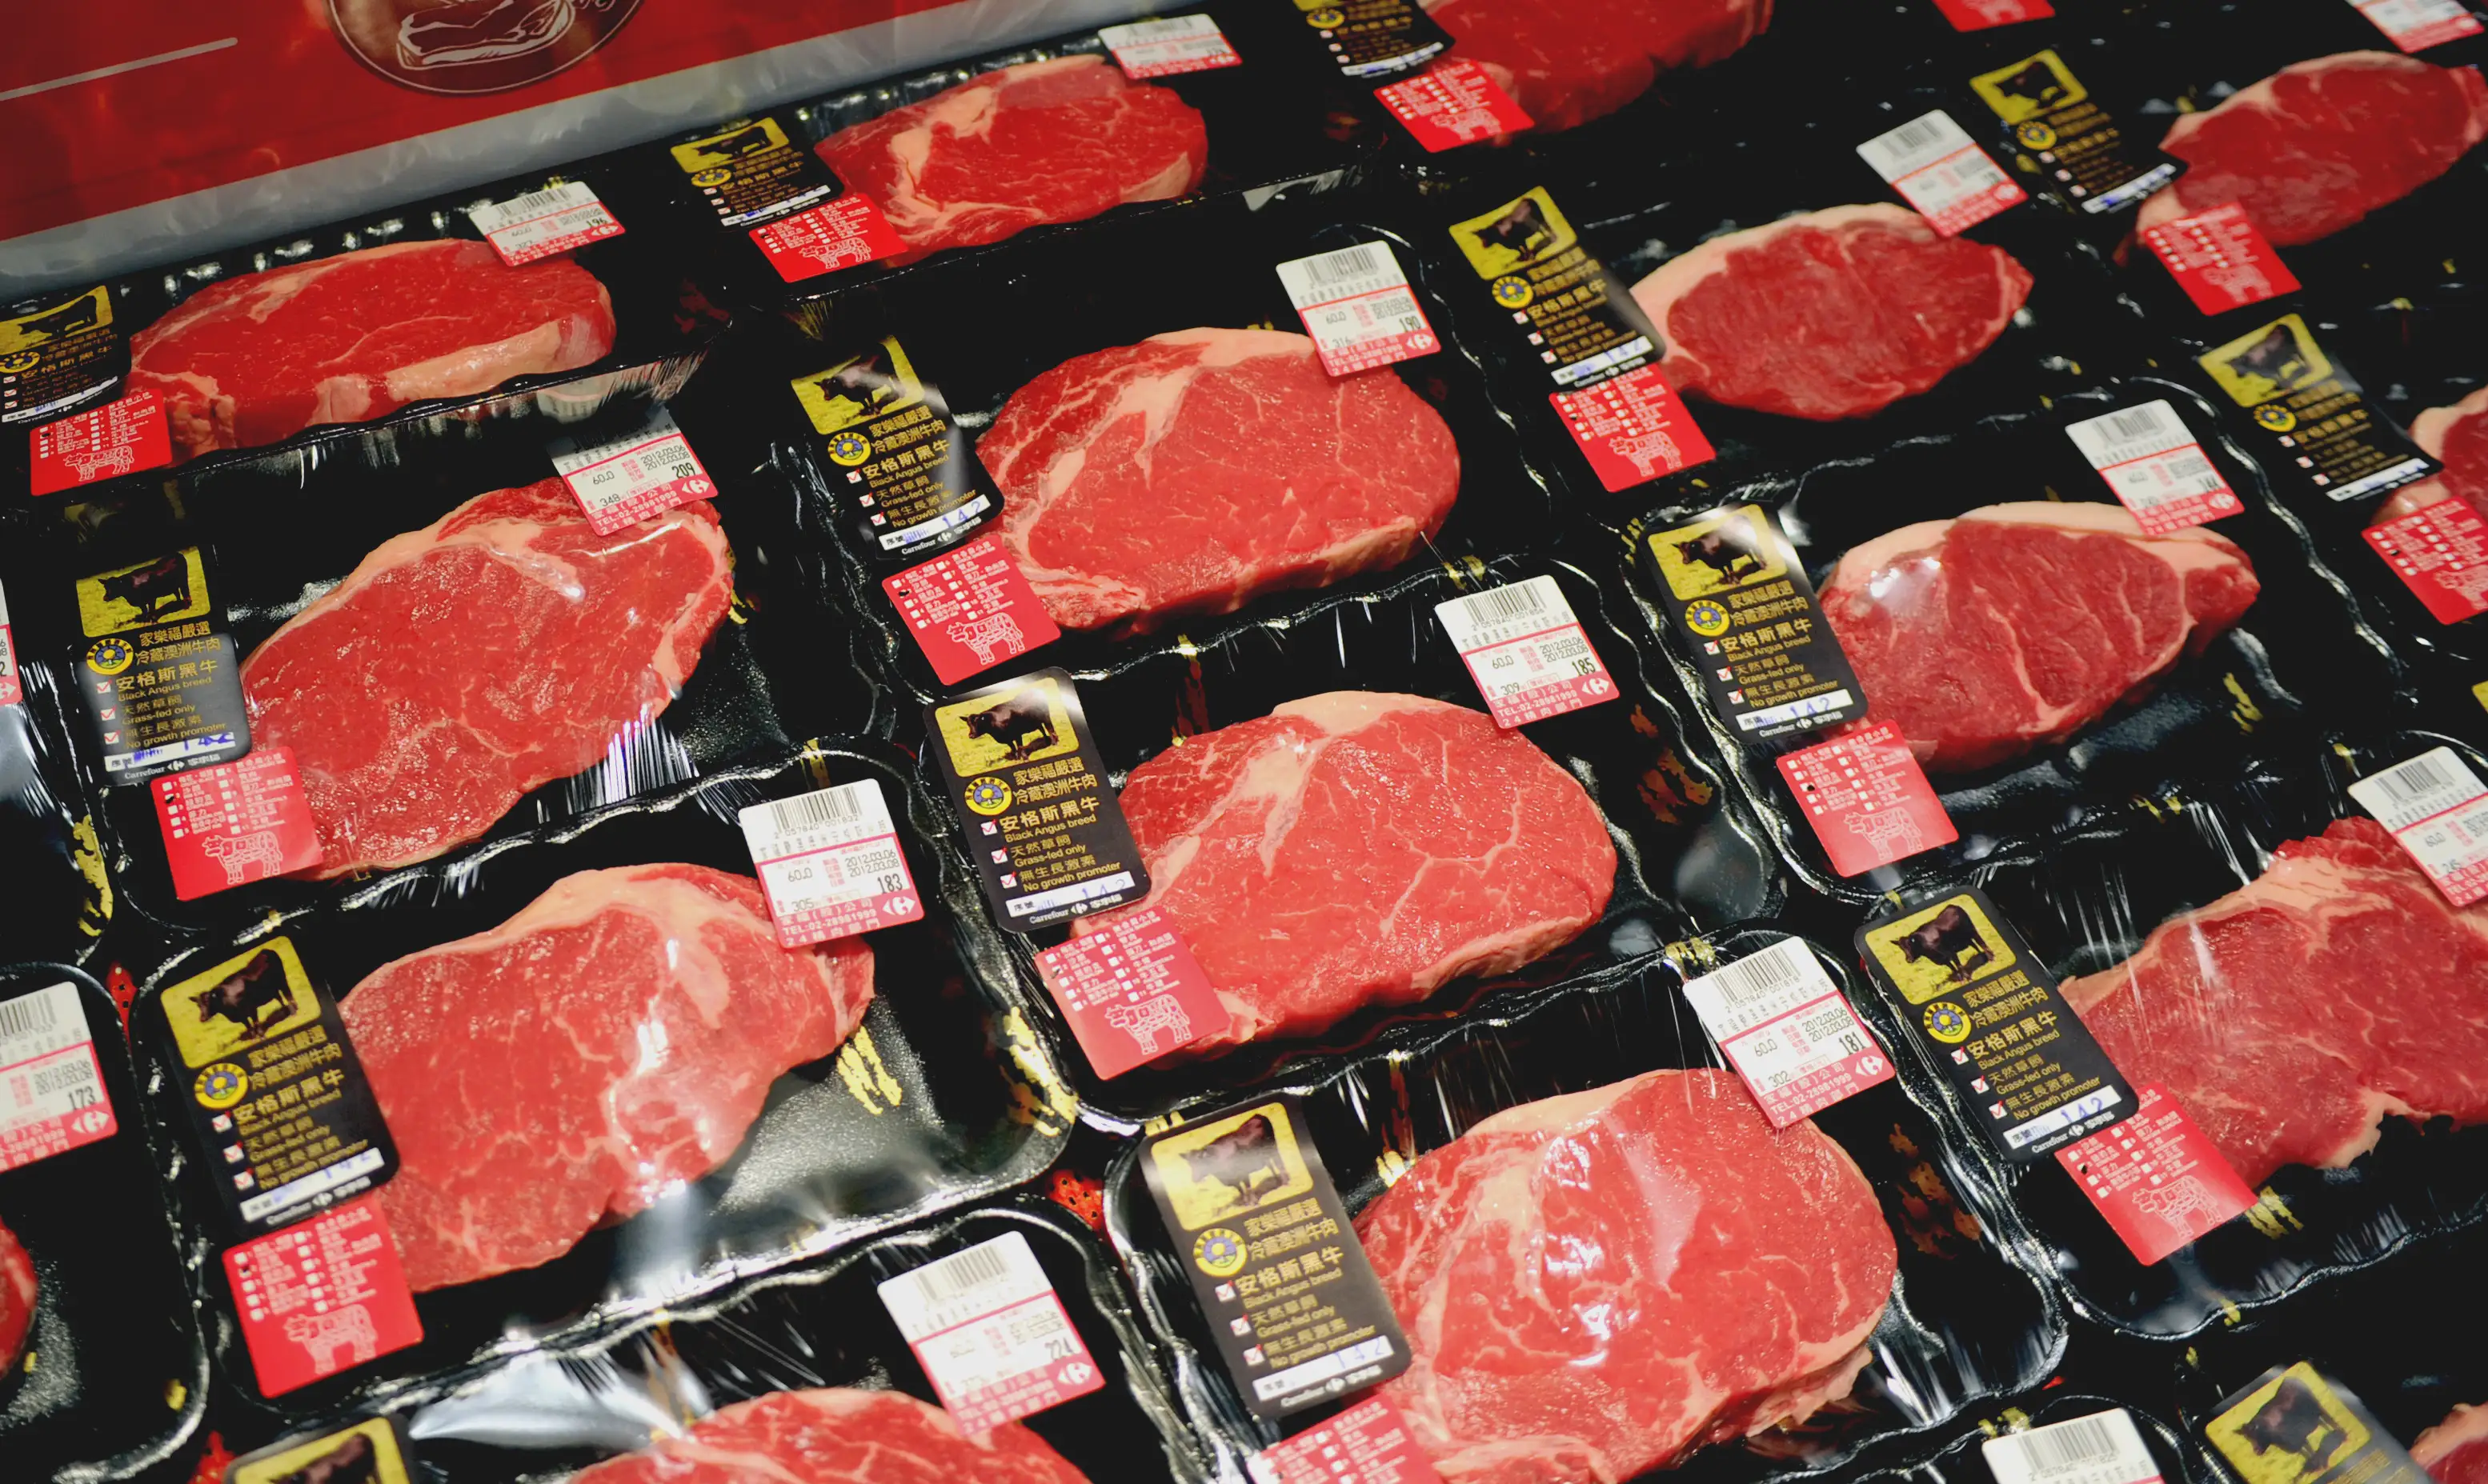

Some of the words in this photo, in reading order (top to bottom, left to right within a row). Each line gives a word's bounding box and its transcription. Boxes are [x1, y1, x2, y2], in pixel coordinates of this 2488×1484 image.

[640, 443, 685, 463] 2012.03.06
[645, 450, 690, 470] 2012.03.08
[860, 437, 952, 478] 安格斯黑牛
[590, 471, 614, 485] 60.0
[671, 461, 696, 480] 209
[869, 473, 895, 486] Black
[895, 462, 924, 478] Angus
[923, 453, 949, 466] breed
[599, 494, 621, 506] 348
[880, 486, 924, 506] Grass-fed
[924, 478, 945, 490] only
[892, 516, 907, 526] No
[907, 504, 939, 522] growth
[938, 488, 977, 509] promoter
[900, 536, 936, 554] Carrefour
[1538, 635, 1583, 653] 2012.03.06
[1719, 617, 1813, 652] 安格斯黑牛
[1544, 644, 1588, 662] 2012.03.08
[1727, 650, 1753, 662] Black
[1753, 642, 1783, 657] Angus
[1783, 635, 1810, 647] breed
[1490, 655, 1513, 668] 60.0
[1571, 657, 1596, 676] 185
[1783, 663, 1805, 675] only
[115, 658, 218, 691] 安格斯黑牛
[118, 690, 145, 701] Black
[148, 683, 179, 697] Angus
[182, 676, 210, 688] breed
[1500, 682, 1520, 694] 309
[1749, 698, 1764, 707] No
[1765, 690, 1797, 706] growth
[1797, 680, 1840, 697] promoter
[122, 709, 170, 724] Grass-fed
[173, 704, 194, 716] only
[125, 739, 139, 748] No
[142, 732, 177, 746] growth
[179, 722, 226, 738] promoter
[124, 766, 164, 779] Carrefour
[1012, 756, 1084, 786] 家樂福嚴選
[1012, 772, 1097, 805] 冷藏澳洲牛肉
[998, 795, 1101, 832] 安格斯黑牛
[1004, 830, 1032, 842] Black
[1034, 822, 1066, 837] Angus
[1067, 814, 1096, 827] breed
[844, 848, 895, 866] 2012.03.06
[1013, 849, 1063, 866] Grass-fed
[1064, 843, 1087, 856] only
[787, 867, 812, 882] 60.0
[848, 858, 899, 877] 2012.03.08
[1023, 882, 1039, 891] No
[1040, 873, 1076, 889] growth
[1076, 861, 1122, 880] promoter
[877, 873, 903, 893] 183
[791, 898, 814, 911] 305
[1028, 906, 1068, 923] Carrefour
[1961, 970, 2030, 1008] 家樂福嚴選
[1969, 986, 2049, 1029] 冷藏澳洲牛肉
[1801, 1006, 1847, 1033] 2012.03.06
[1808, 1017, 1854, 1042] 2012.03.08
[1838, 1031, 1866, 1054] 181
[1965, 1009, 2061, 1059] 安格斯黑牛
[1752, 1038, 1777, 1057] 60.0
[1977, 1054, 2005, 1070] Black
[2004, 1042, 2035, 1061] Angus
[2032, 1030, 2060, 1046] breed
[1768, 1070, 1791, 1087] 302
[1995, 1070, 2041, 1095] Grass-fed
[2039, 1062, 2062, 1078] only
[67, 1086, 96, 1110] 173
[2013, 1108, 2029, 1120] No
[2028, 1094, 2062, 1116] growth
[2059, 1077, 2103, 1102] promoter
[2029, 1131, 2069, 1154] Carrefour
